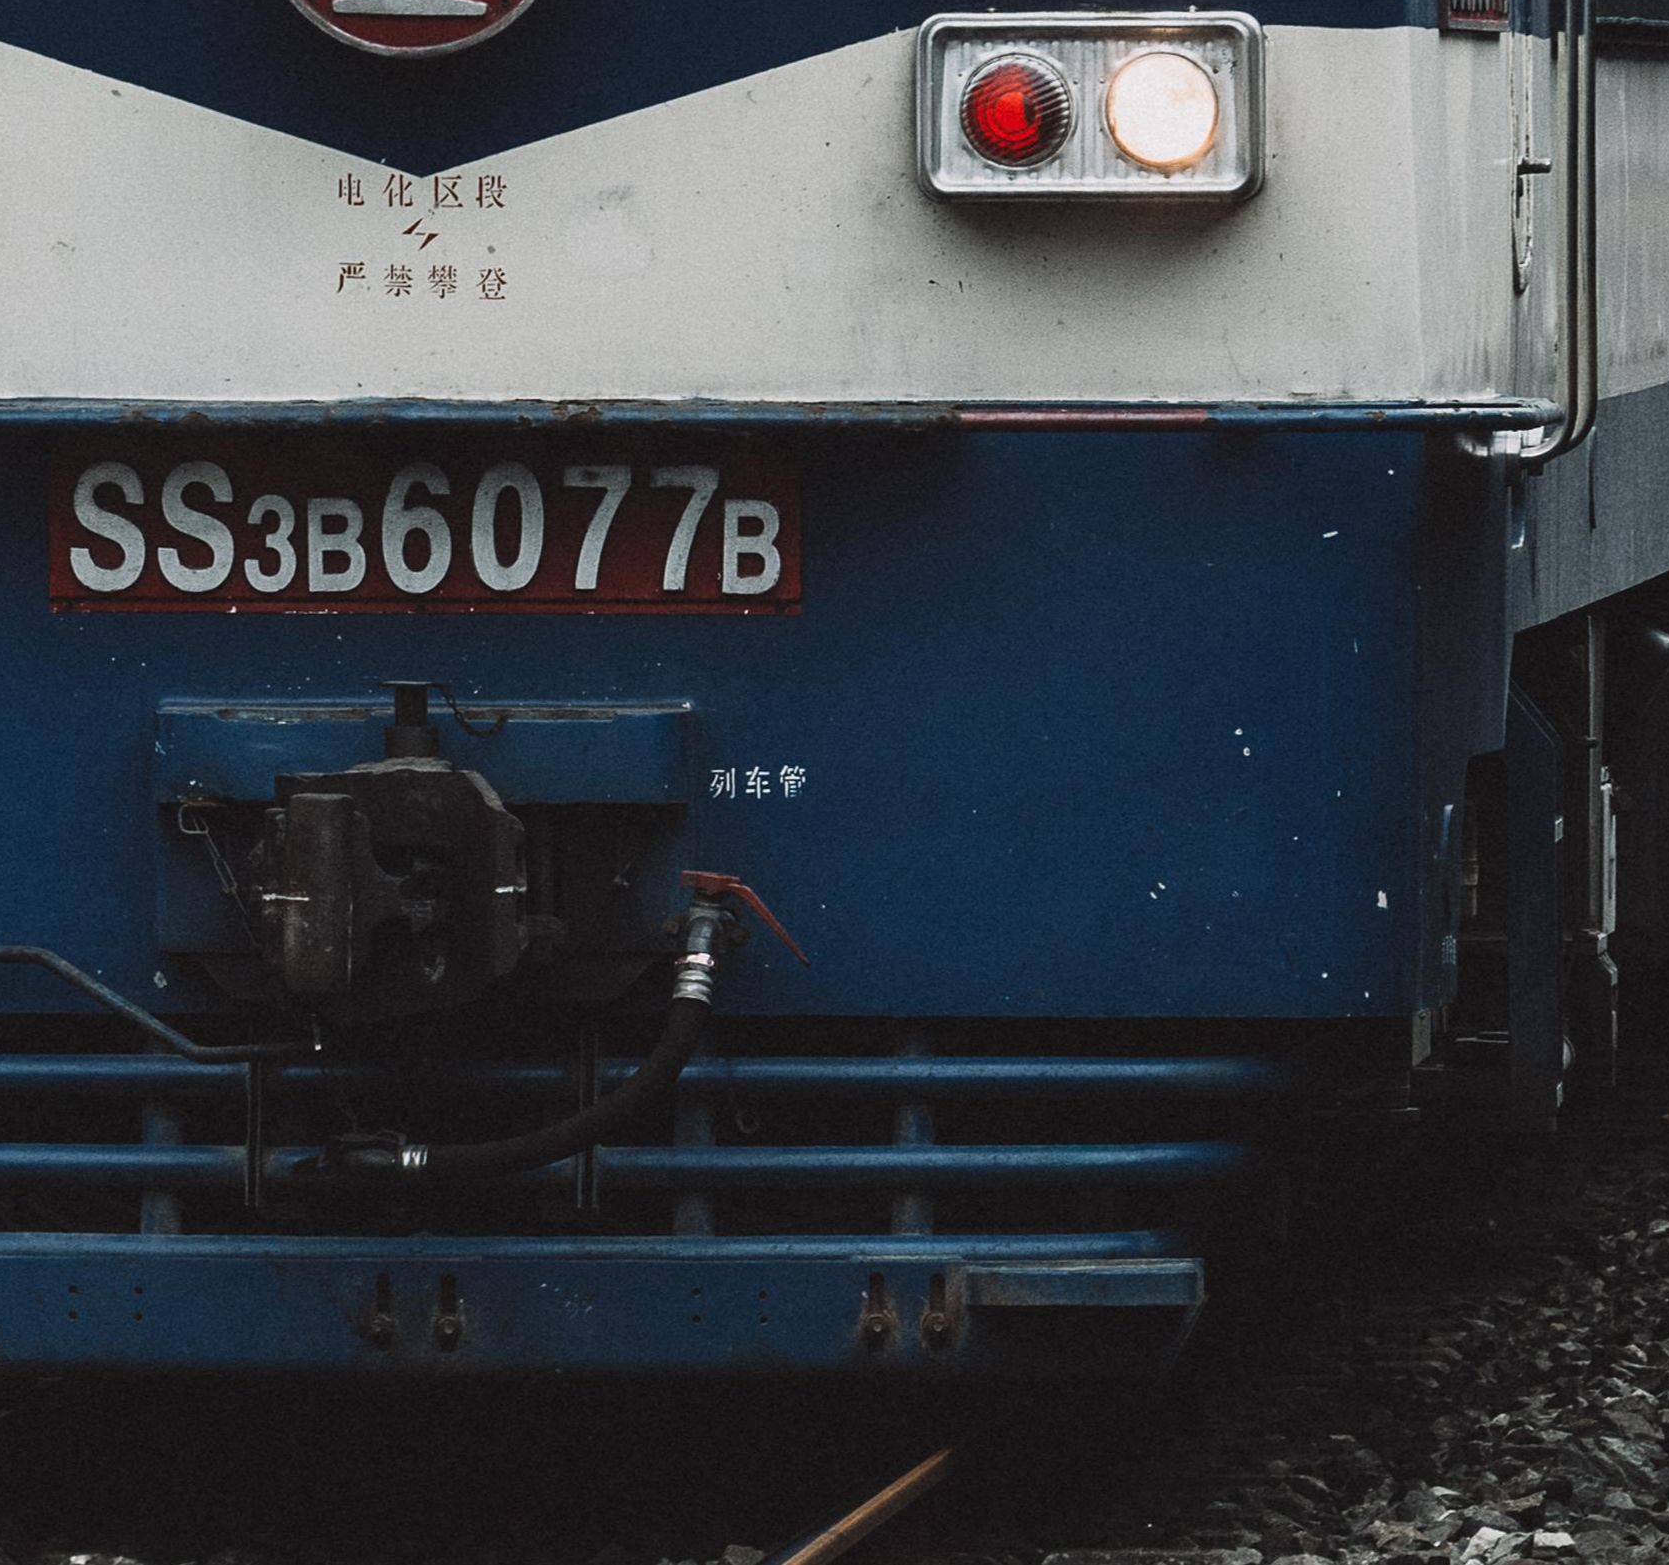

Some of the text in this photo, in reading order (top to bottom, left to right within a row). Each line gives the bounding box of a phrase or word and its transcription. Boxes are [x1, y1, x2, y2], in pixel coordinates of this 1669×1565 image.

[337, 173, 508, 208] 电化区段
[336, 261, 508, 300] 严禁攀登
[69, 461, 782, 594] SS3B6077B
[709, 764, 806, 800] 列车管
